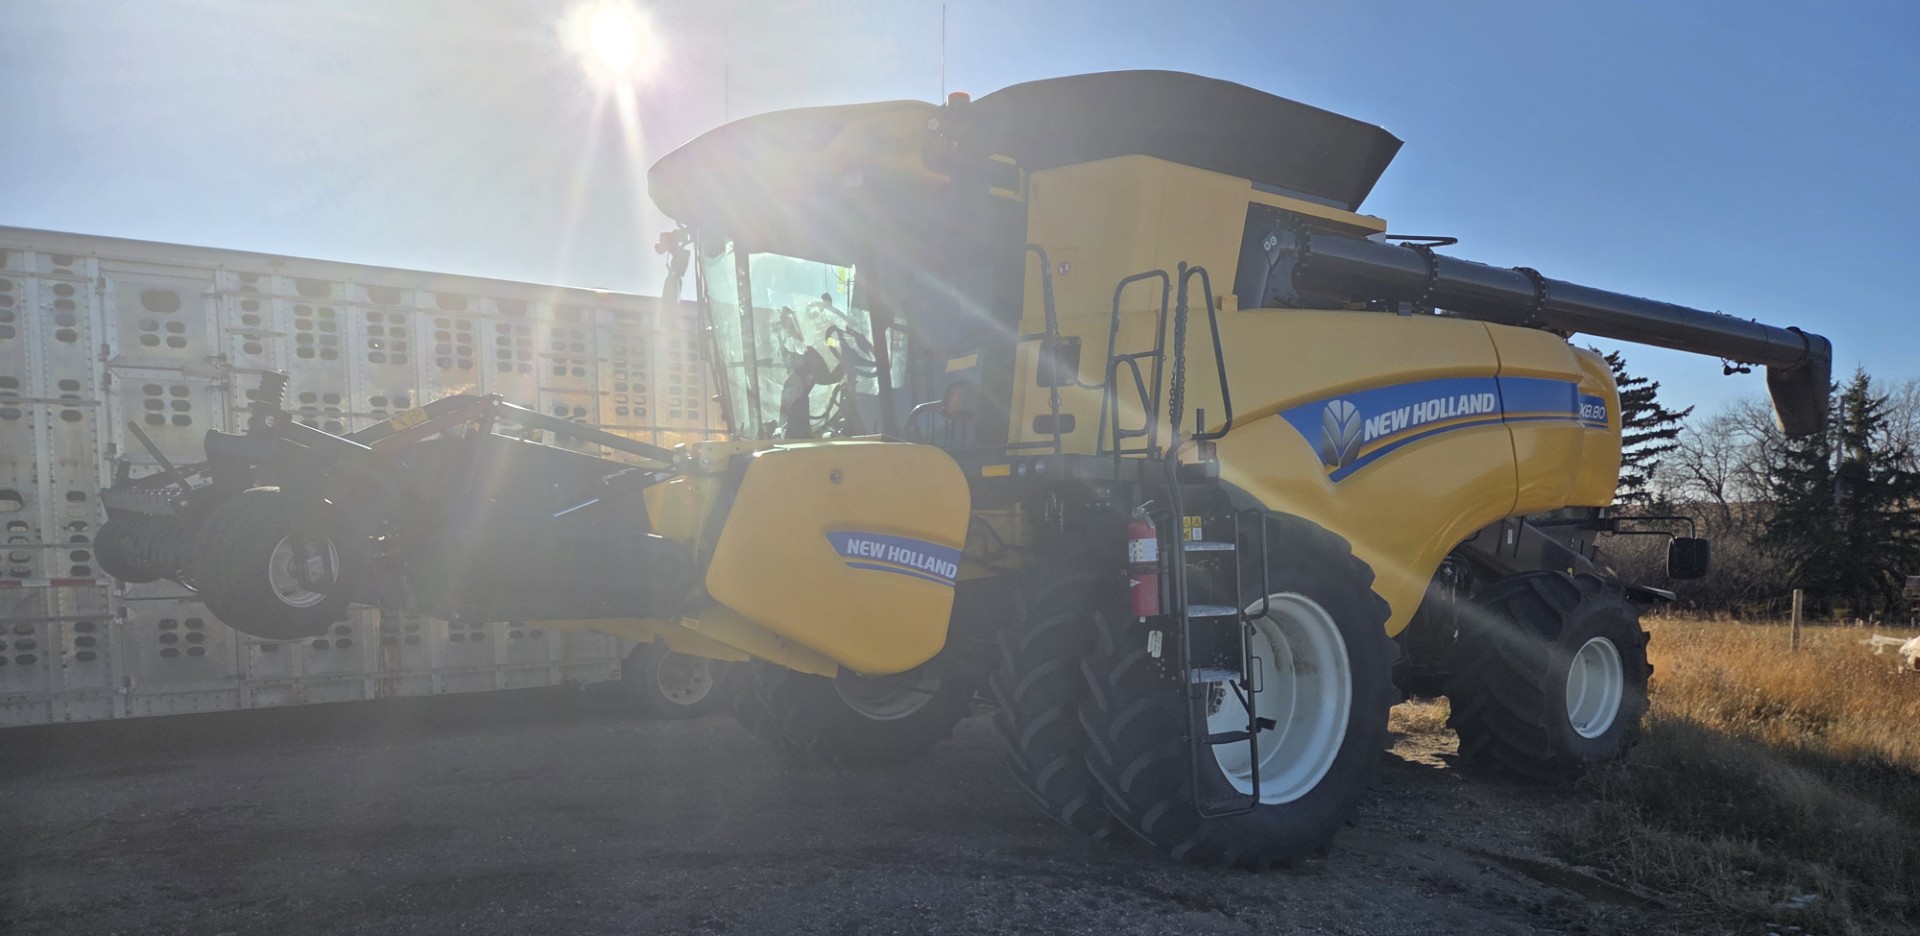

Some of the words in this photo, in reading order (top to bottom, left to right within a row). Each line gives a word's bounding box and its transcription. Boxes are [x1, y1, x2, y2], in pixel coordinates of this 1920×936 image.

[1364, 406, 1411, 442] NEW
[1412, 393, 1496, 425] HOLLAND
[847, 538, 886, 560] NEW
[887, 546, 958, 579] HOLLAND
